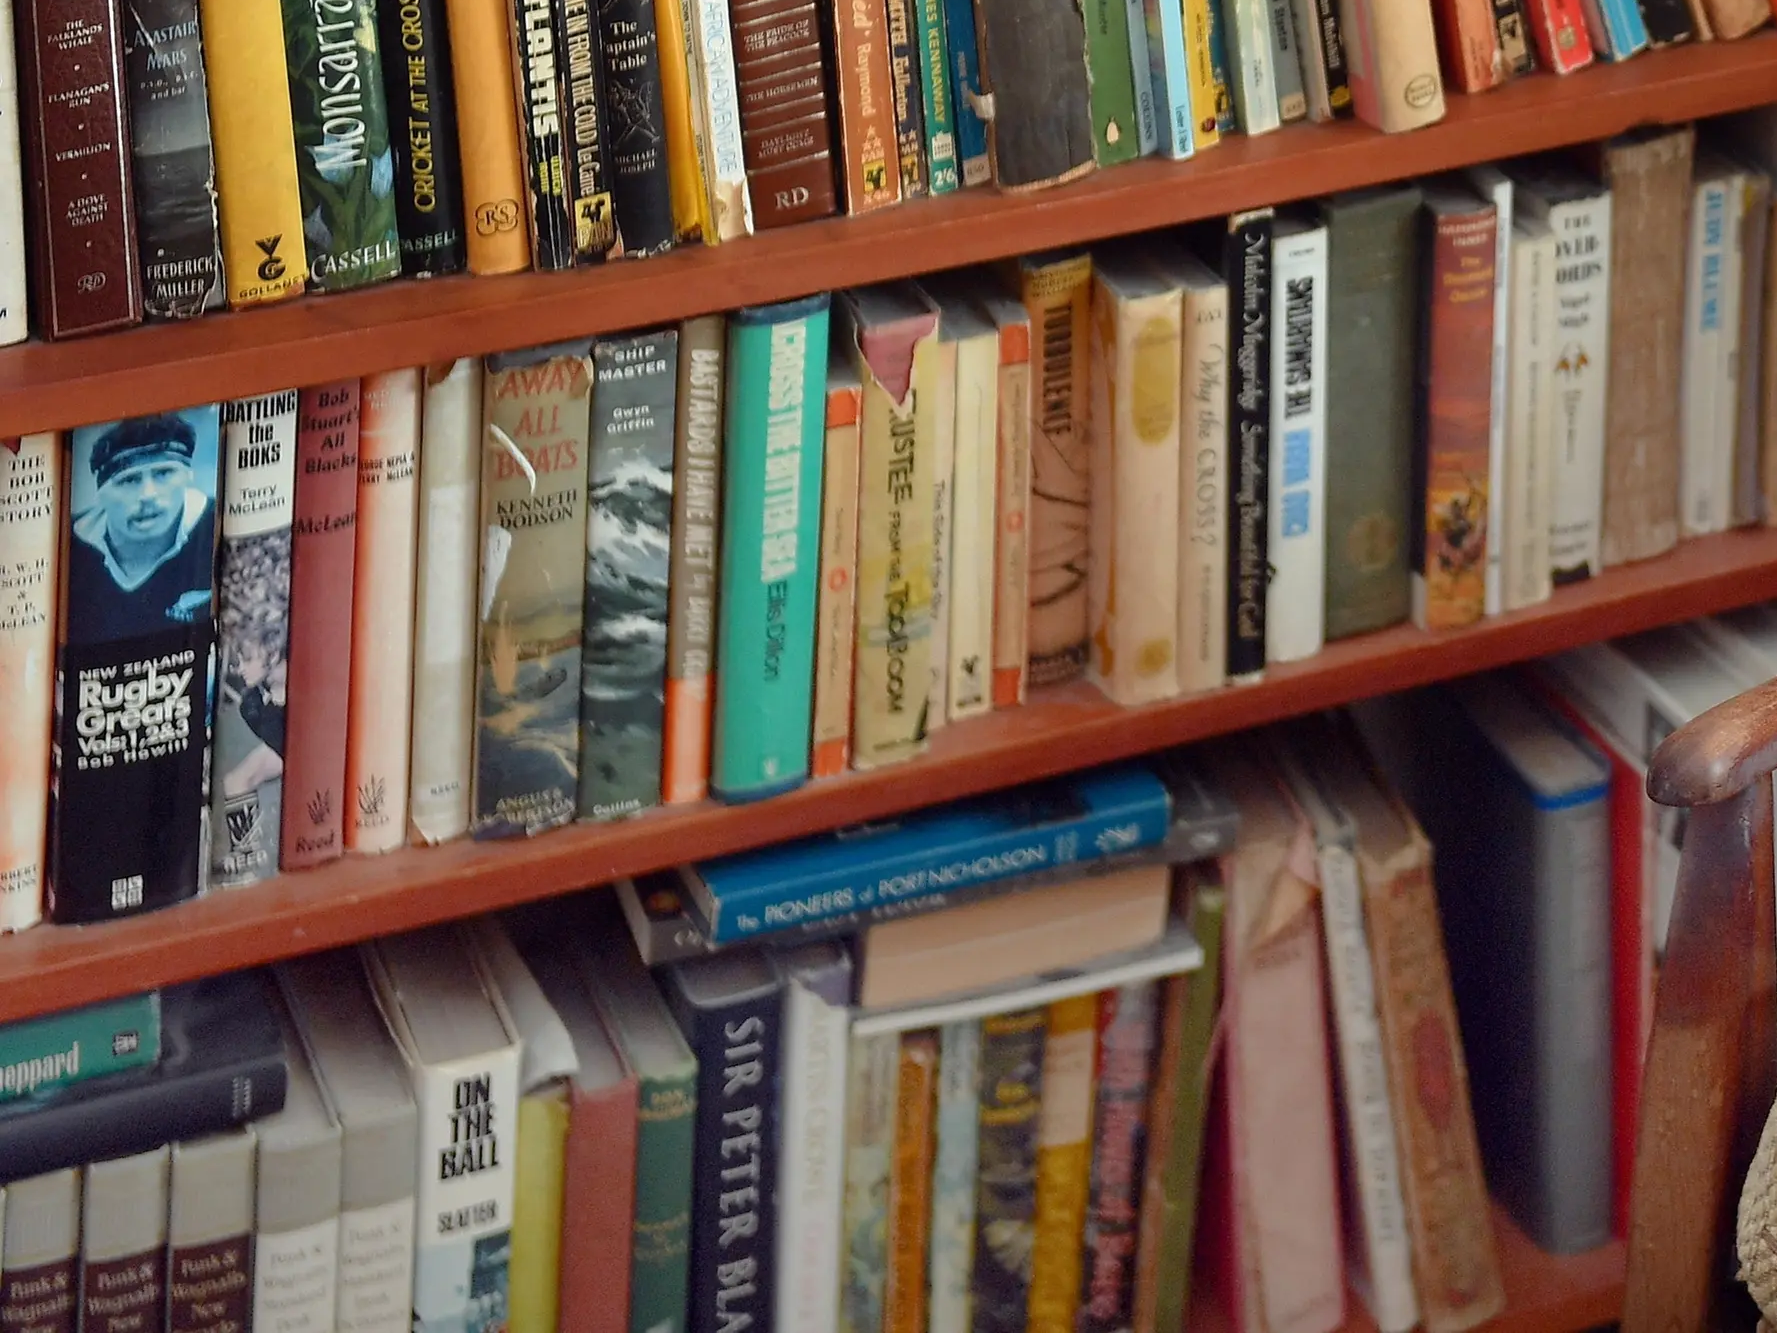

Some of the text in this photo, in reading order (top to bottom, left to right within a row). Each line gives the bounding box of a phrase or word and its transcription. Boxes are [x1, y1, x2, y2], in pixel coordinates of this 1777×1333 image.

[566, 14, 590, 35] IN
[610, 21, 637, 36] The
[147, 49, 188, 72] MARS
[569, 33, 595, 81] FROM
[608, 55, 647, 72] Table
[408, 56, 427, 87] THE
[855, 42, 877, 116] Raymond
[927, 27, 946, 123] KENNAWAY
[572, 75, 597, 108] THE
[706, 1, 737, 174] AFRICAN ADVENTURE
[411, 89, 429, 113] AT
[575, 104, 598, 147] COLD
[55, 142, 111, 162] VERMILION
[409, 117, 436, 213] CRICKET
[774, 187, 809, 210] RD
[147, 256, 214, 280] FREDERICK
[311, 240, 397, 284] CASSELL
[154, 279, 205, 300] MULLER
[614, 345, 655, 362] SHIP
[496, 358, 586, 399] AWAY
[598, 359, 667, 382] MASTER
[226, 391, 297, 424] BATTLING
[318, 389, 349, 408] Bob
[687, 348, 719, 454] BASTARDS
[513, 404, 563, 438] ALL
[613, 404, 650, 420] Gwyn
[248, 423, 274, 444] the
[606, 418, 655, 435] Griffin
[320, 433, 345, 451] All
[8, 454, 46, 472] THE
[238, 444, 281, 469] BOKS
[687, 456, 716, 467] I
[9, 472, 45, 489] BOB
[240, 485, 277, 501] Terry
[228, 496, 285, 516] McLean
[496, 489, 578, 516] KENNETH
[685, 468, 716, 519] HAVE
[499, 506, 574, 530] DODSON
[763, 623, 786, 682] Dillon
[78, 650, 195, 681] NEW ZEALAND
[79, 667, 194, 710] Rugby
[77, 695, 191, 737] Greats
[78, 754, 114, 771] Bob
[593, 798, 642, 815] Collins
[765, 887, 854, 925] PIONEERS
[878, 871, 926, 900] PORT
[927, 845, 1046, 886] NICHOLSON
[455, 1072, 491, 1110] ON
[449, 1104, 495, 1143] THE
[718, 1015, 765, 1247] SIR PETER
[439, 1136, 500, 1182] BALL
[437, 1200, 498, 1234] SLATTER
[181, 1255, 219, 1277] Funk
